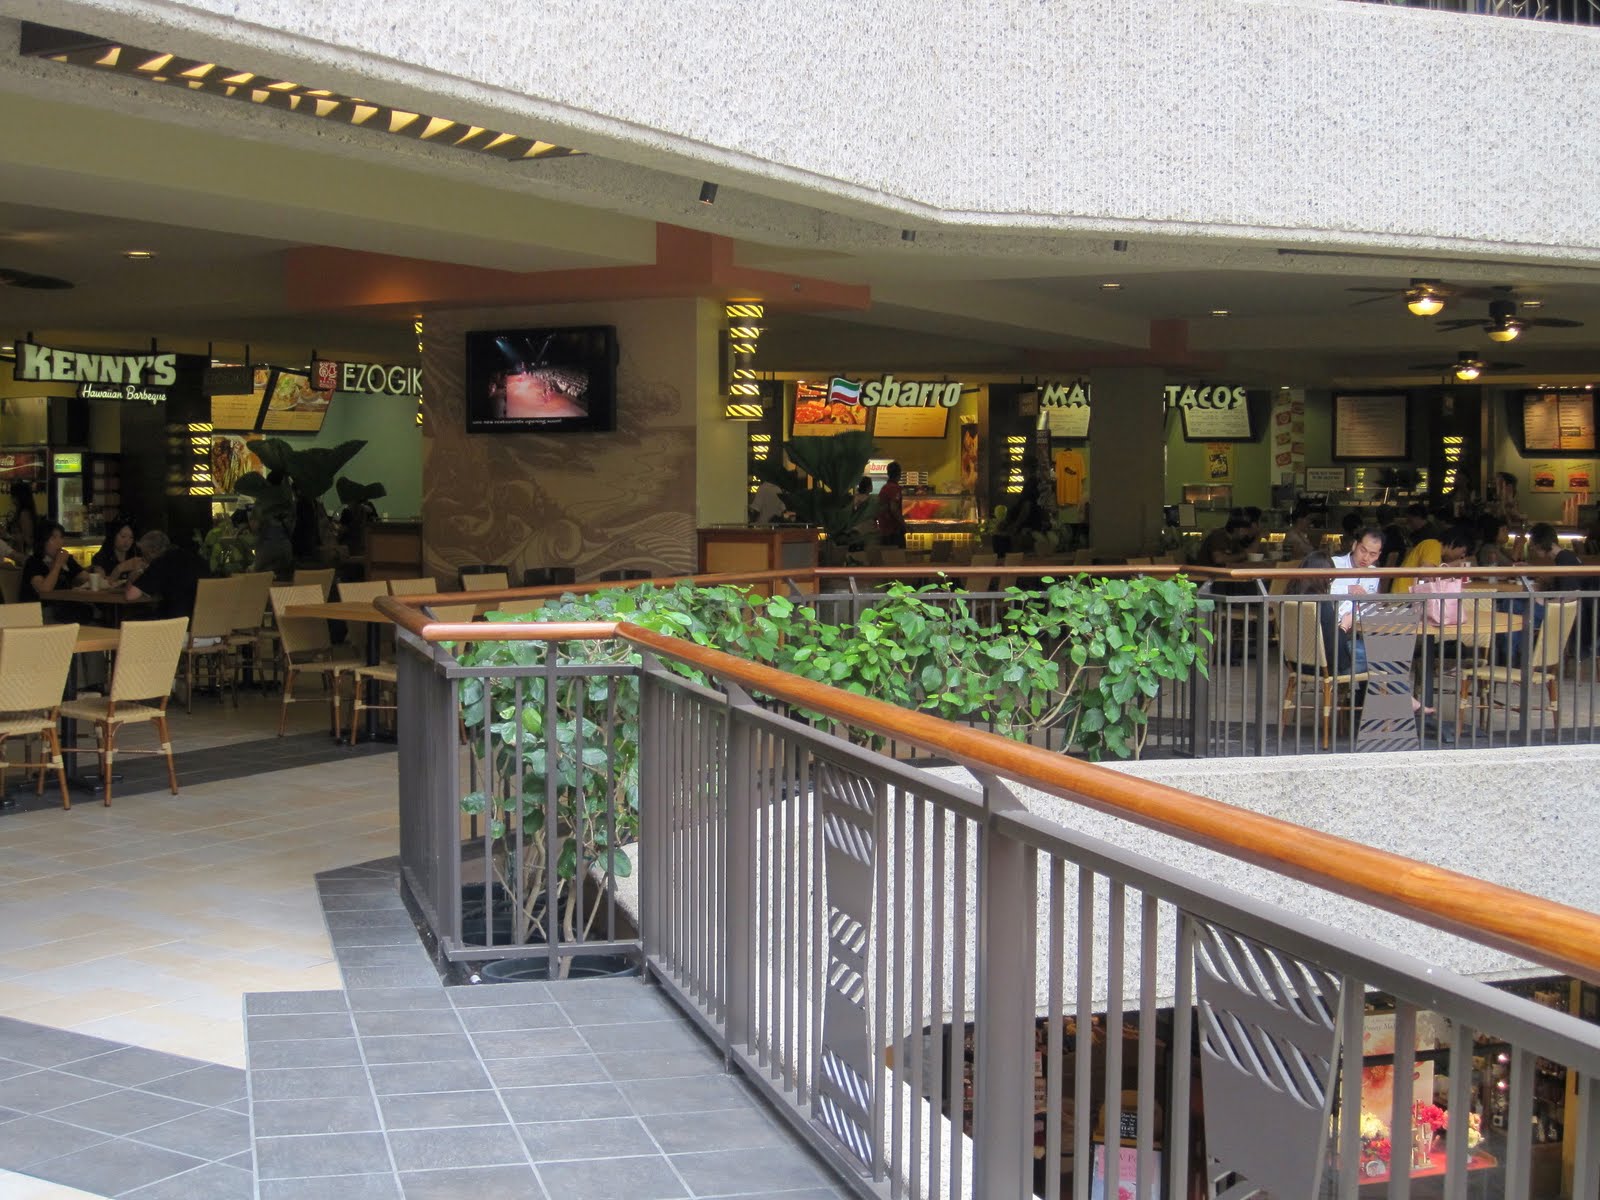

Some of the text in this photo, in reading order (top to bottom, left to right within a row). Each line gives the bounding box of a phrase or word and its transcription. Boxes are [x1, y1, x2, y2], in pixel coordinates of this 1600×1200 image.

[23, 343, 177, 386] KENNY'S
[343, 363, 423, 394] EZOGIK
[82, 383, 167, 404] Hawaiian Barbeque
[862, 375, 961, 407] sbarro
[1042, 383, 1091, 405] MA
[1165, 385, 1246, 408] TACOS
